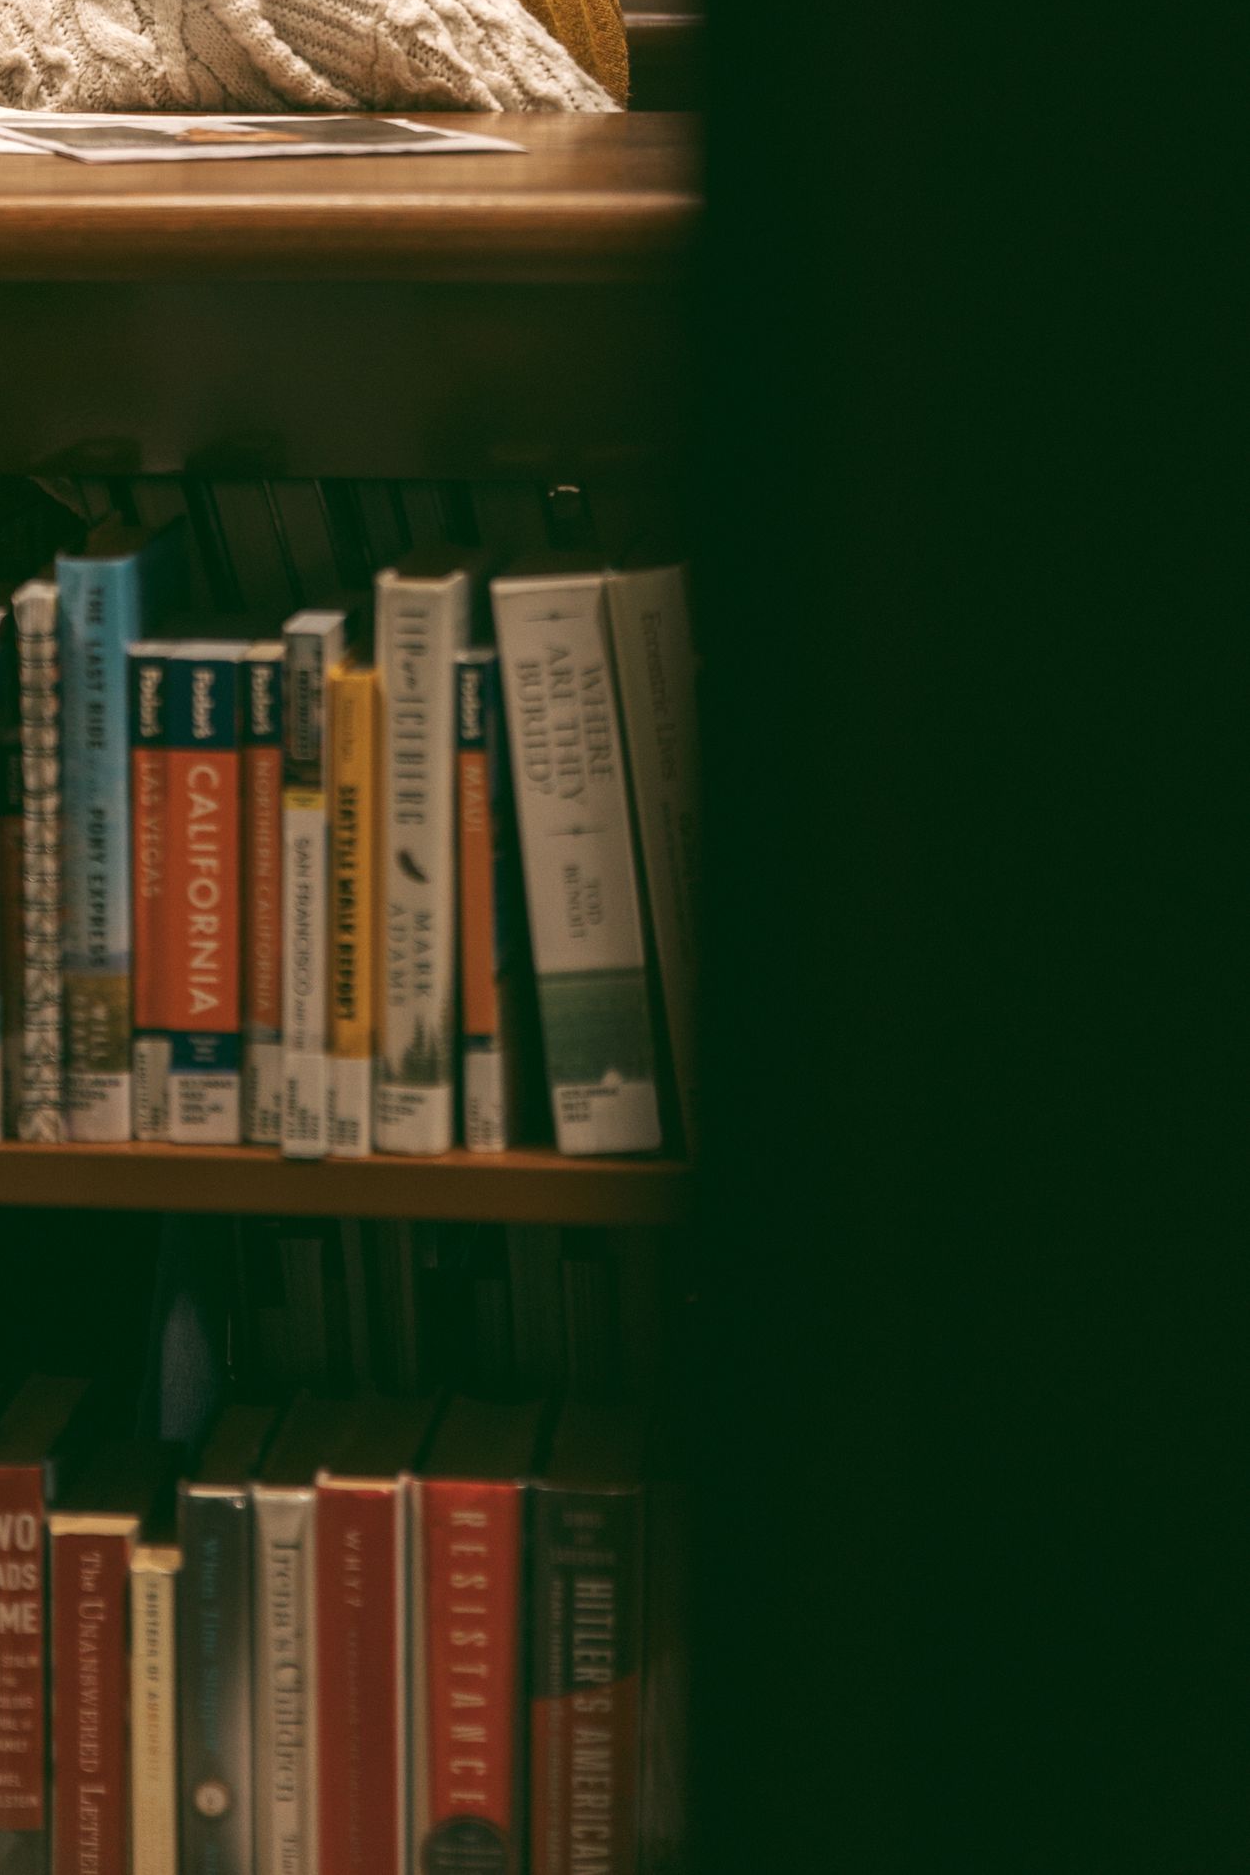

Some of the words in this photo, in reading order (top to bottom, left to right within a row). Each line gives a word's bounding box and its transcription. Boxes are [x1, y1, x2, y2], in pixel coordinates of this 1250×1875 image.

[87, 587, 105, 624] THE
[86, 639, 105, 691] LAST
[140, 667, 163, 737] Fodor's
[193, 669, 216, 740] Fodor's
[252, 667, 274, 735] Fodor's
[460, 669, 481, 740] Fodor's
[546, 646, 576, 699] ARE
[86, 701, 106, 750] RIDE
[395, 694, 430, 826] ICEBERG
[582, 665, 614, 777] WHERE
[141, 762, 160, 805] LAS
[464, 765, 482, 832] MAUI
[554, 720, 587, 806] THEY
[89, 805, 107, 864] PONY
[141, 816, 161, 899] VEGAS
[255, 760, 272, 877] NORTHERN
[295, 837, 312, 877] SAN
[337, 786, 360, 870] SEATTLE
[89, 874, 107, 968] EXPRESS
[186, 764, 221, 1015] CALIFORNIA
[336, 877, 359, 934] WALK
[256, 885, 273, 1011] CALIFORNIA
[294, 882, 314, 996] FRANCISCO
[388, 903, 408, 1006] ADAMS
[413, 912, 432, 999] MARK
[336, 943, 358, 1022] REPORT
[79, 1552, 102, 1592] The
[78, 1599, 108, 1773] UNANSWERED
[449, 1510, 488, 1805] RESISTANCE
[573, 1580, 614, 1713] HITLER'S
[275, 1661, 305, 1801] Children
